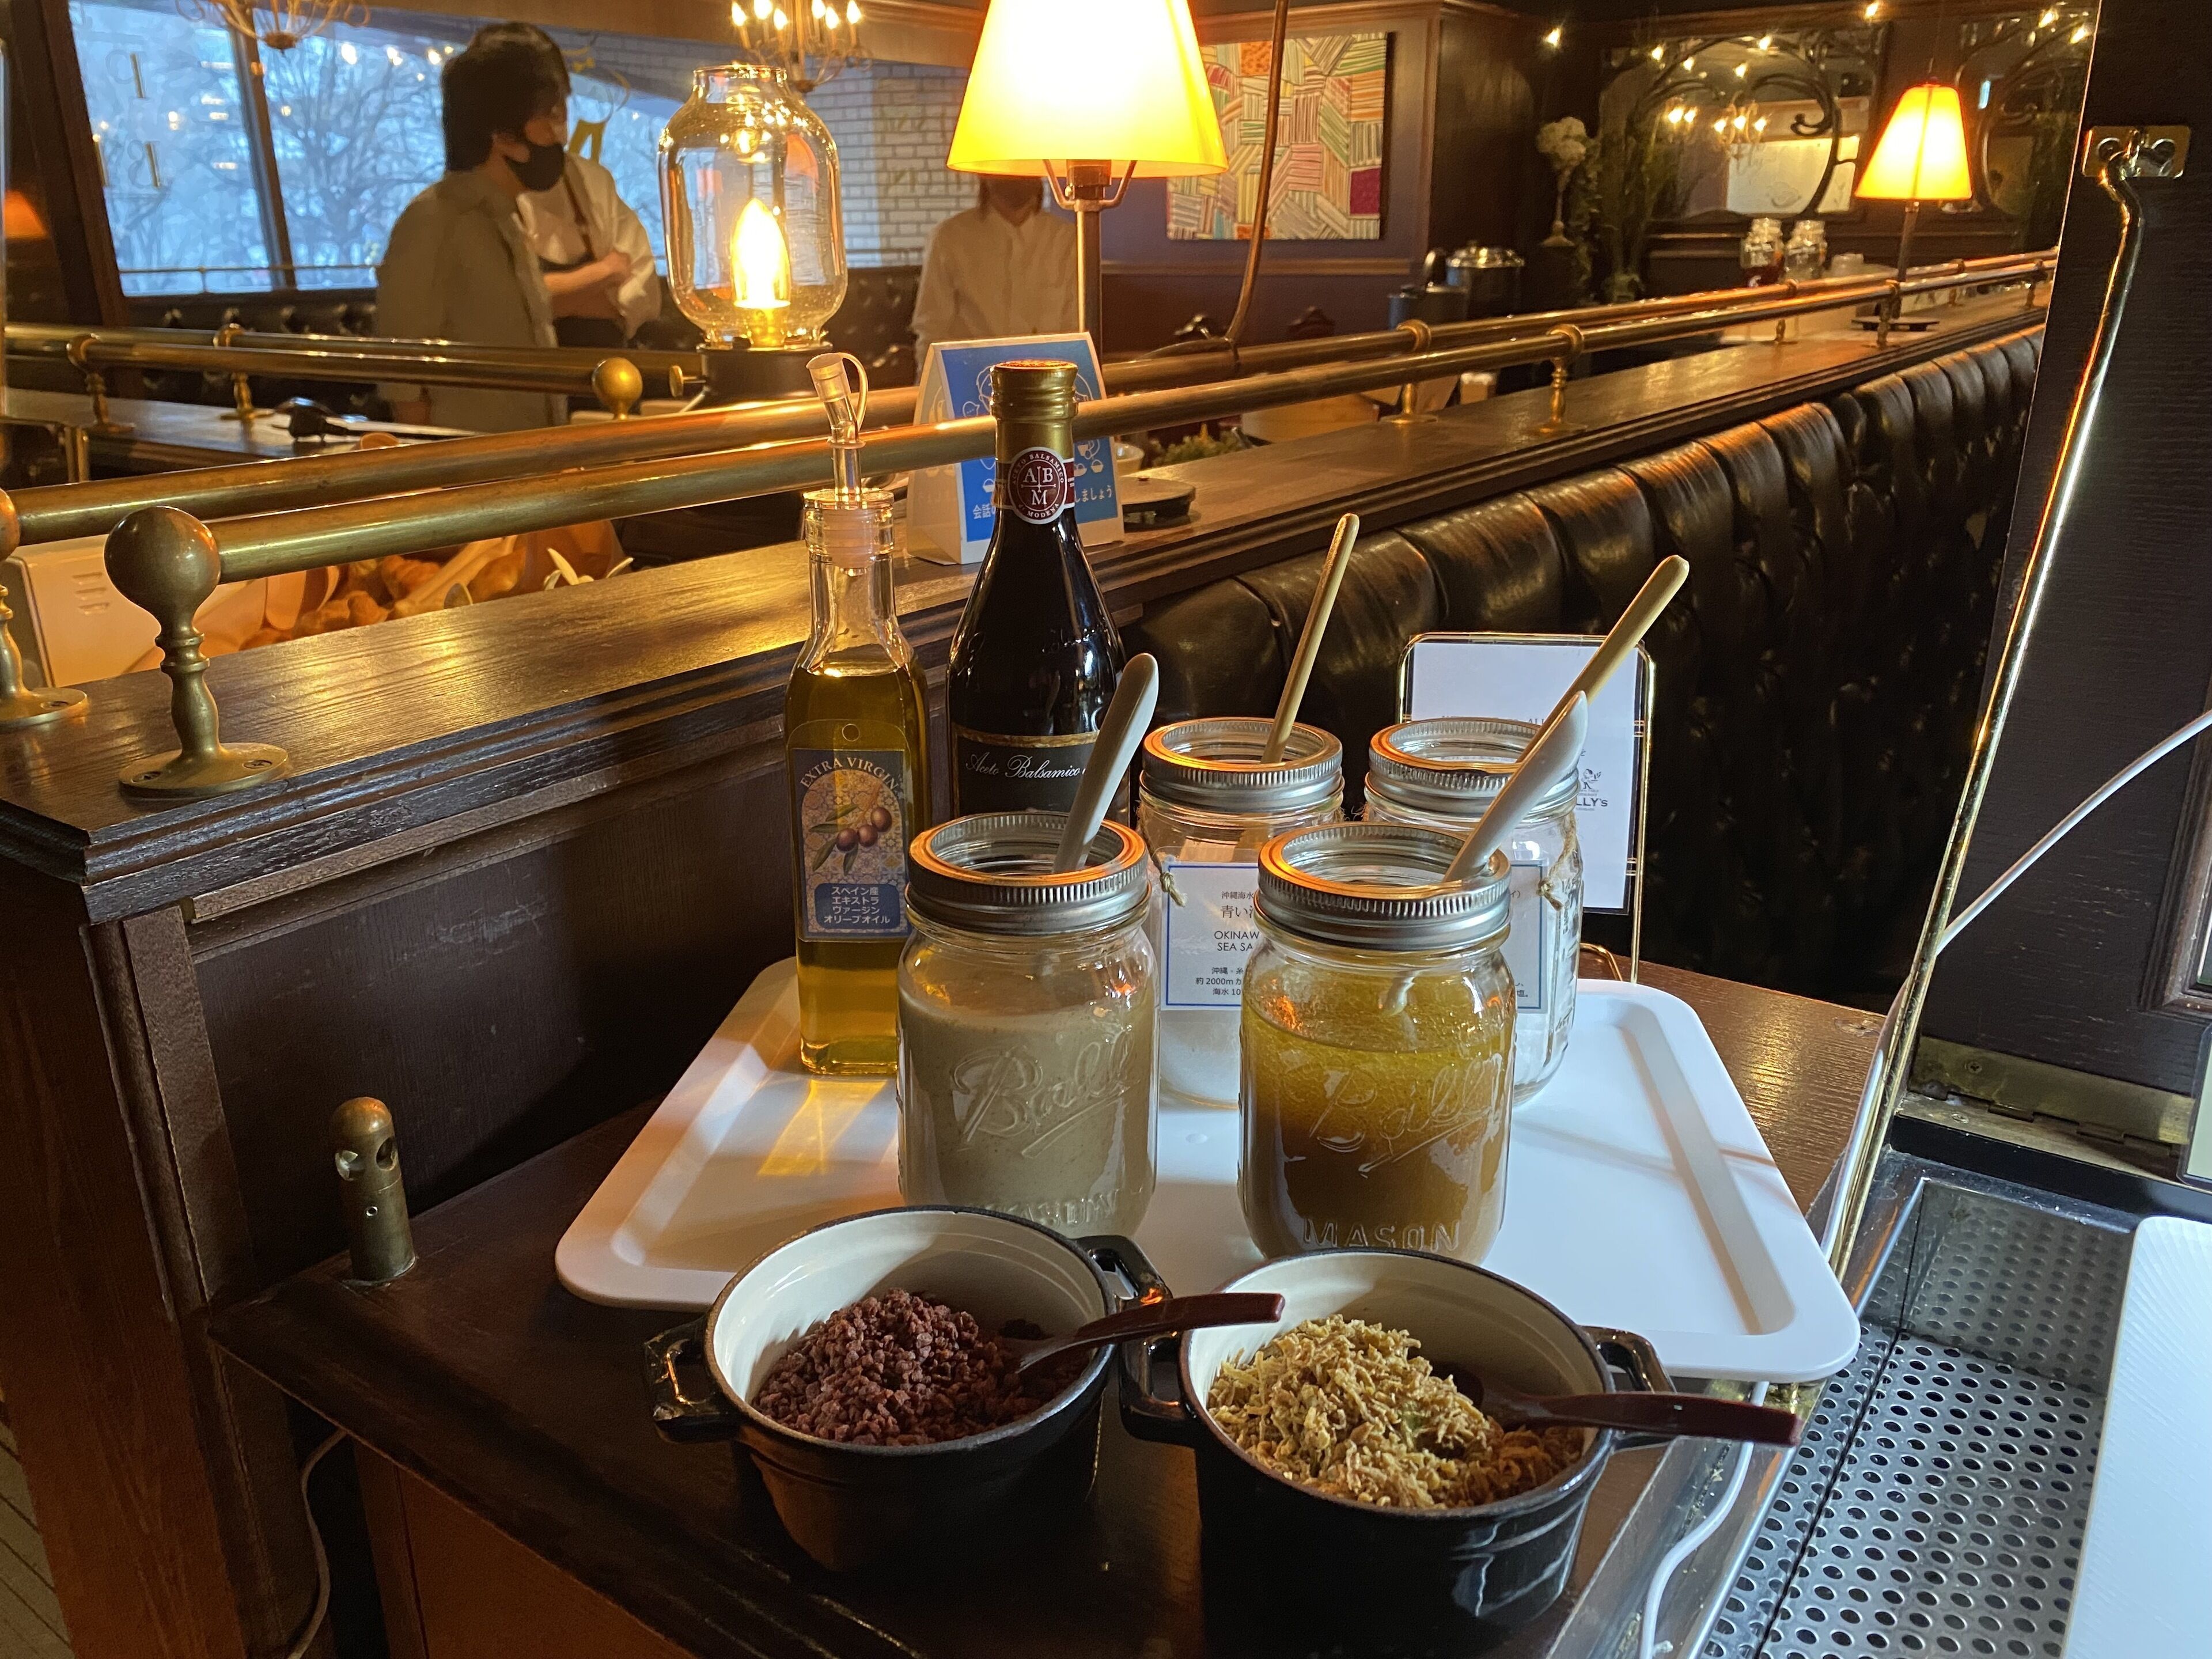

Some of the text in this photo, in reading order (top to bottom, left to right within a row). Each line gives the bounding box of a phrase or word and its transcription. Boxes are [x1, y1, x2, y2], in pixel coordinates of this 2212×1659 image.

[1029, 453, 1065, 483] BALSAMICO
[1027, 503, 1059, 518] MODENA
[965, 752, 1081, 779] Aceto Balsamico
[800, 757, 899, 790] EXTRA VIRGIN
[831, 887, 879, 896] スペイン産
[832, 896, 880, 905] エキストラ
[832, 906, 880, 915] ヴァージン
[824, 915, 891, 924] オリーブオイル
[1217, 942, 1237, 951] SEA
[1302, 1215, 1460, 1252] MASON
